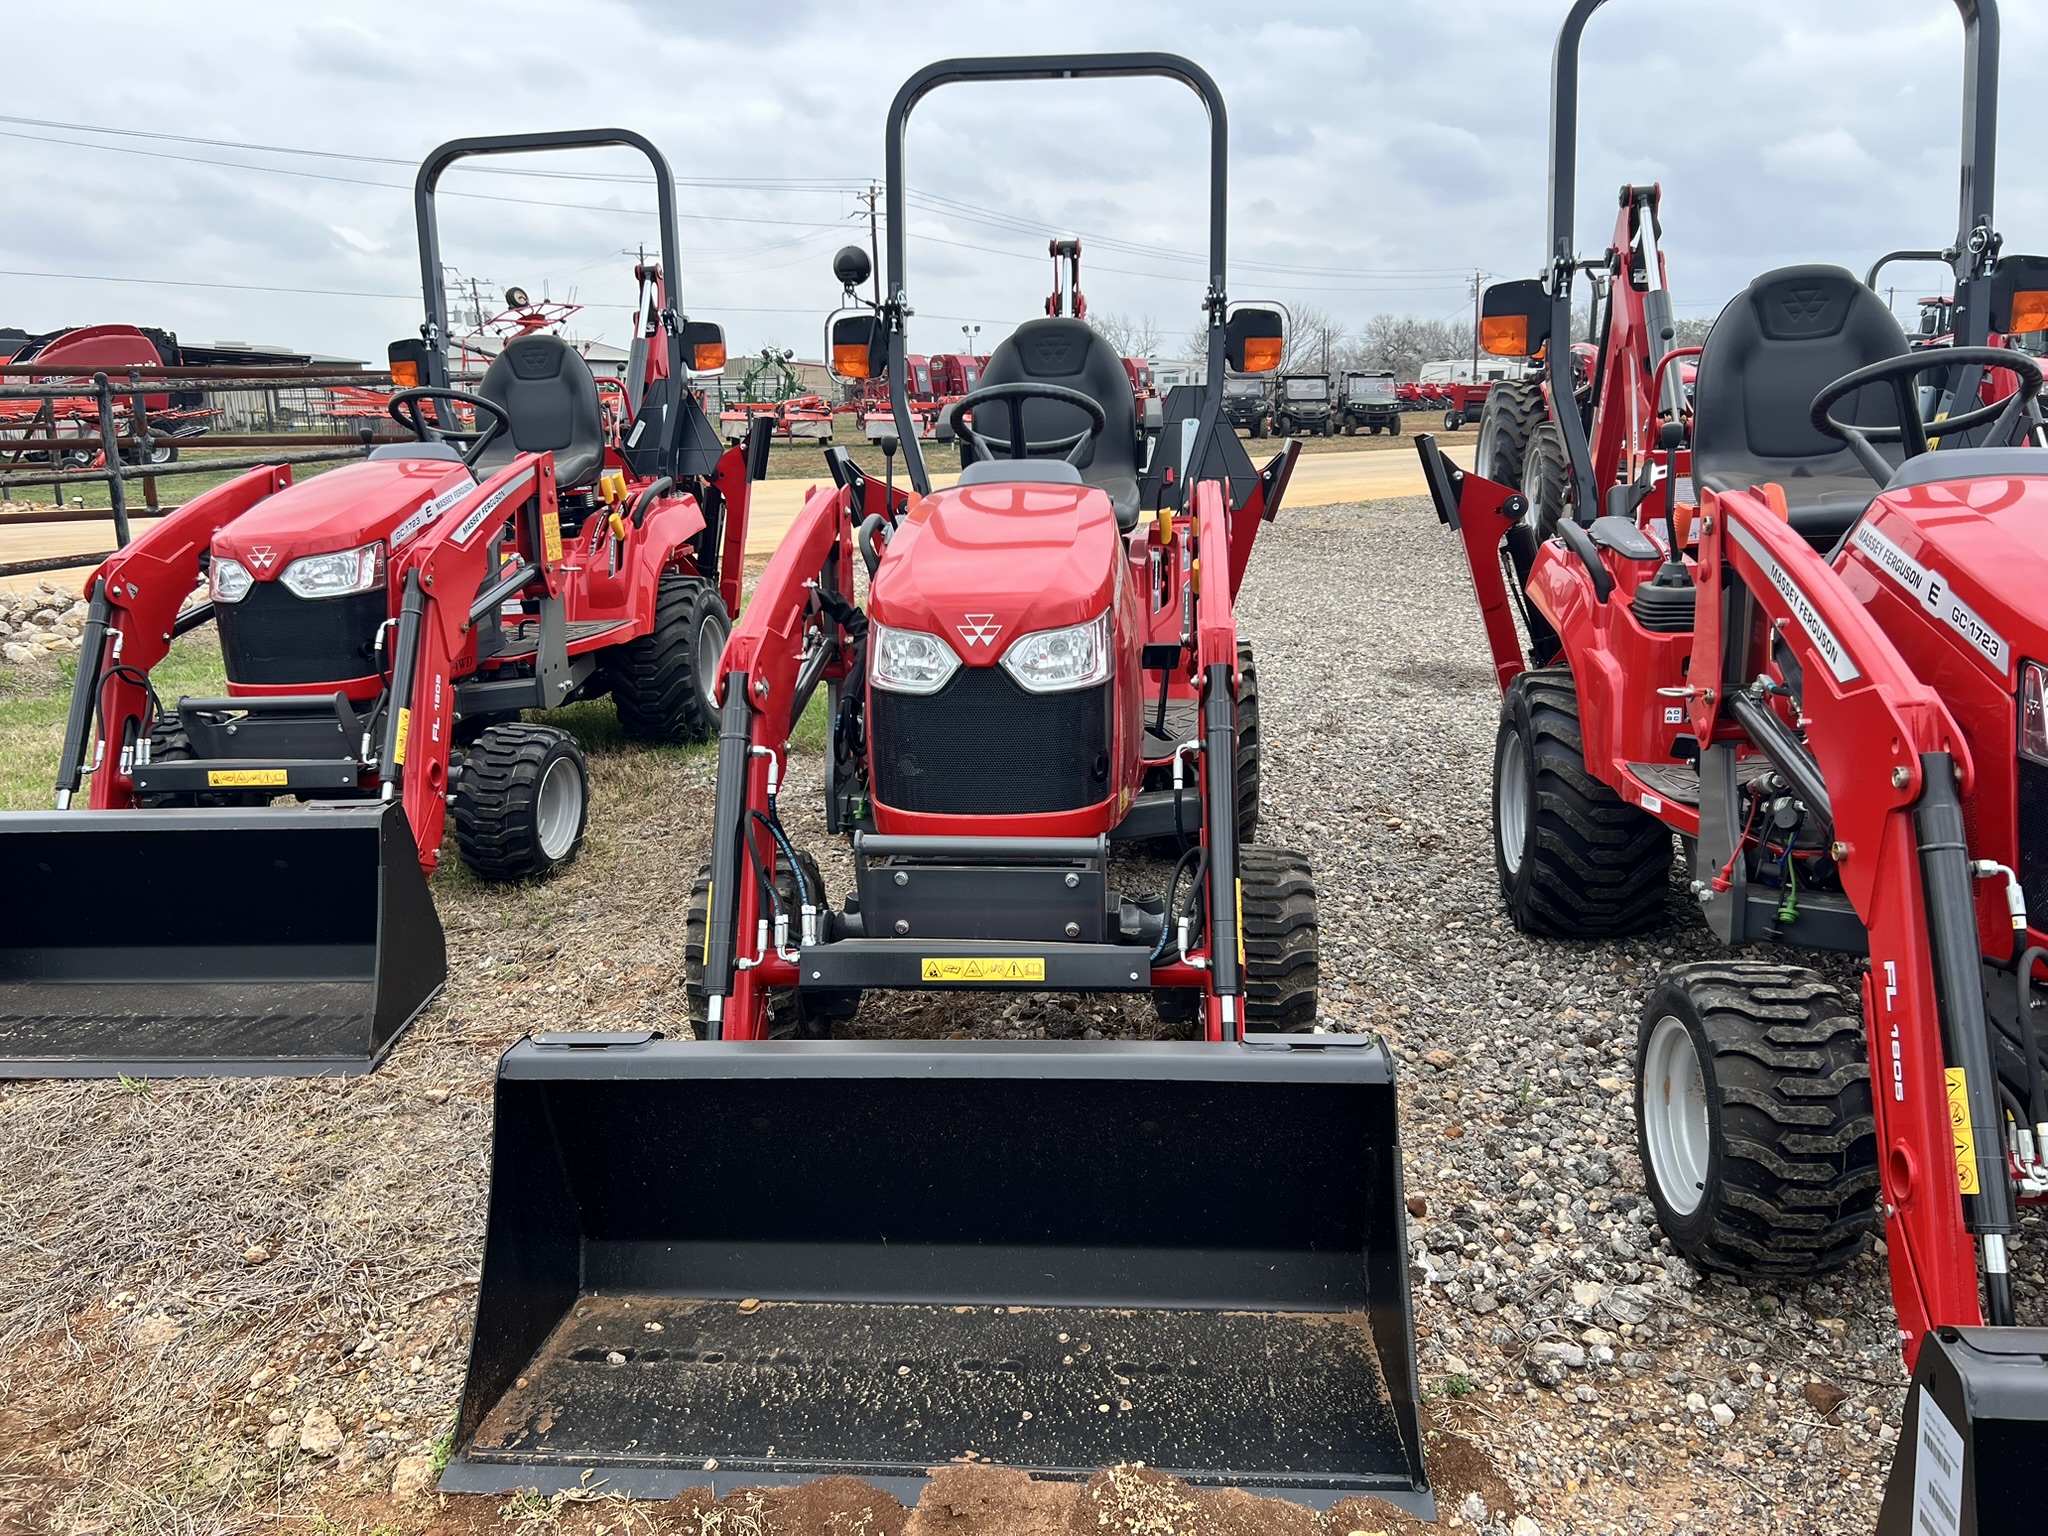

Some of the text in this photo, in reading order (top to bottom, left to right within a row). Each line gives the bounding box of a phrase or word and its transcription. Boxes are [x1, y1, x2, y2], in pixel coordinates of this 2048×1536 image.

[424, 505, 434, 519] E
[435, 493, 454, 511] MASSEY
[453, 482, 475, 501] FERGUSON
[462, 490, 506, 536] MASSEY FERGUSON
[1857, 527, 1884, 557] MASSEY
[1882, 548, 1923, 590] FERGUSON
[1927, 581, 1941, 607] E
[1770, 564, 1838, 664] MASSEY FERGUSON
[452, 655, 473, 672] 4WD
[431, 717, 440, 742] FL
[1883, 960, 1904, 1101] FL 1805
